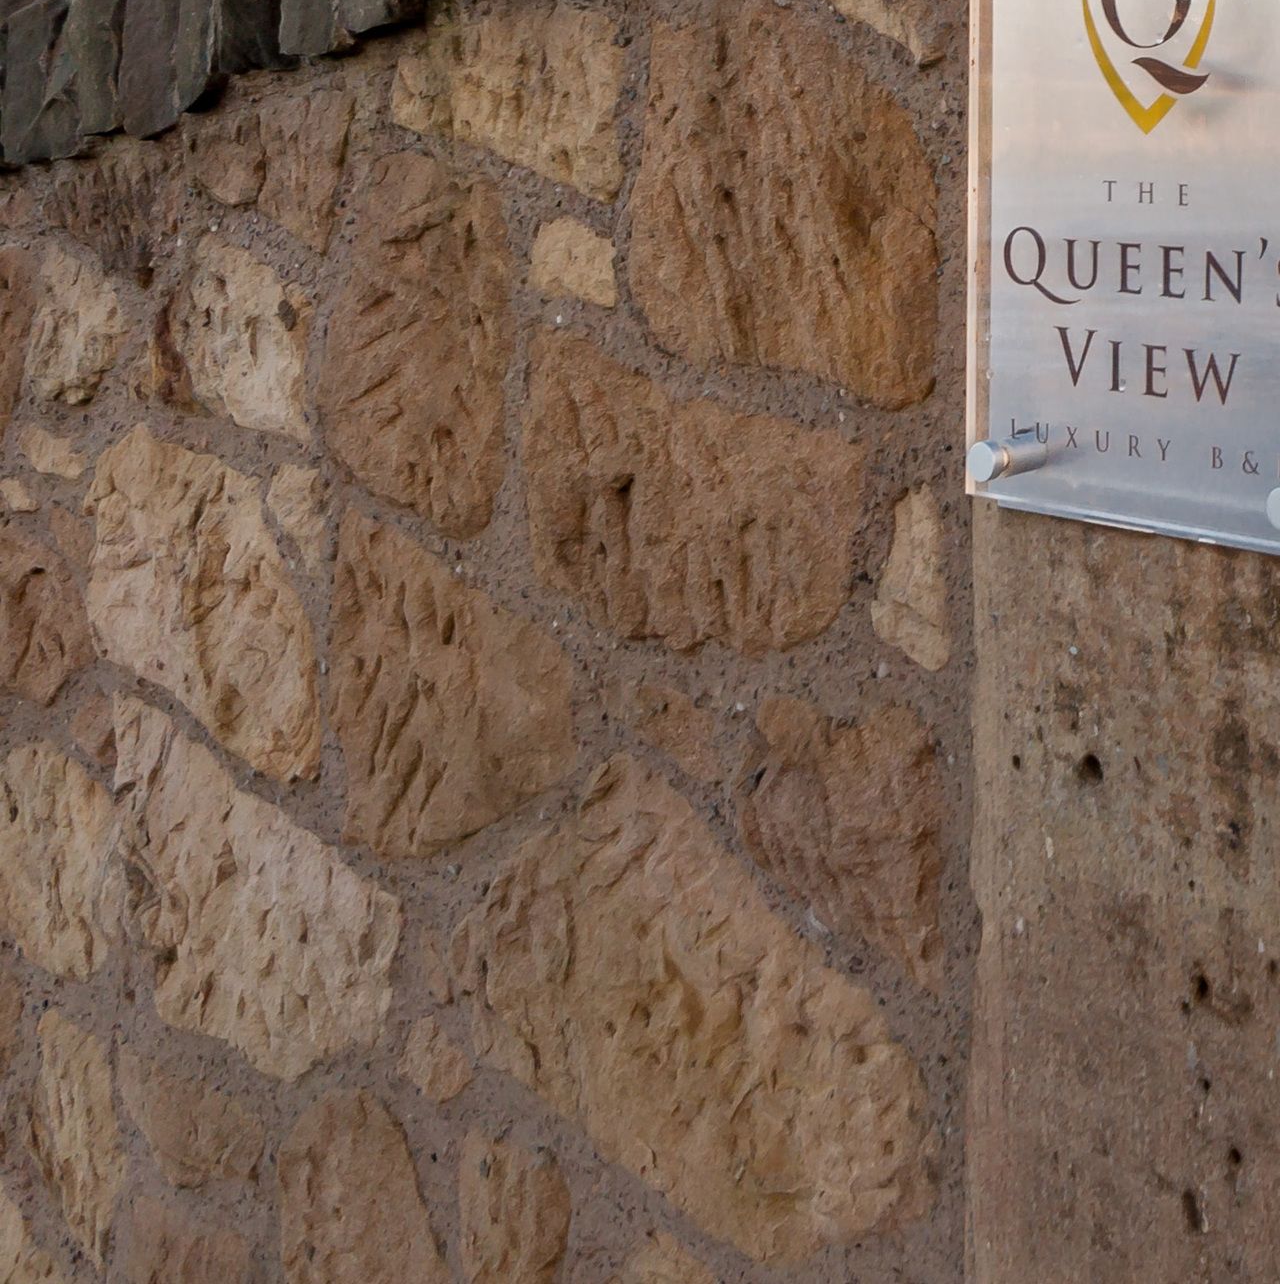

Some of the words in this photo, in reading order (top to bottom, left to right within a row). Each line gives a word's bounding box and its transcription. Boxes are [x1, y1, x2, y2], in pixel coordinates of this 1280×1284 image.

[1102, 180, 1189, 206] THE
[1053, 325, 1241, 405] VIEW
[1010, 418, 1171, 461] LUXURY
